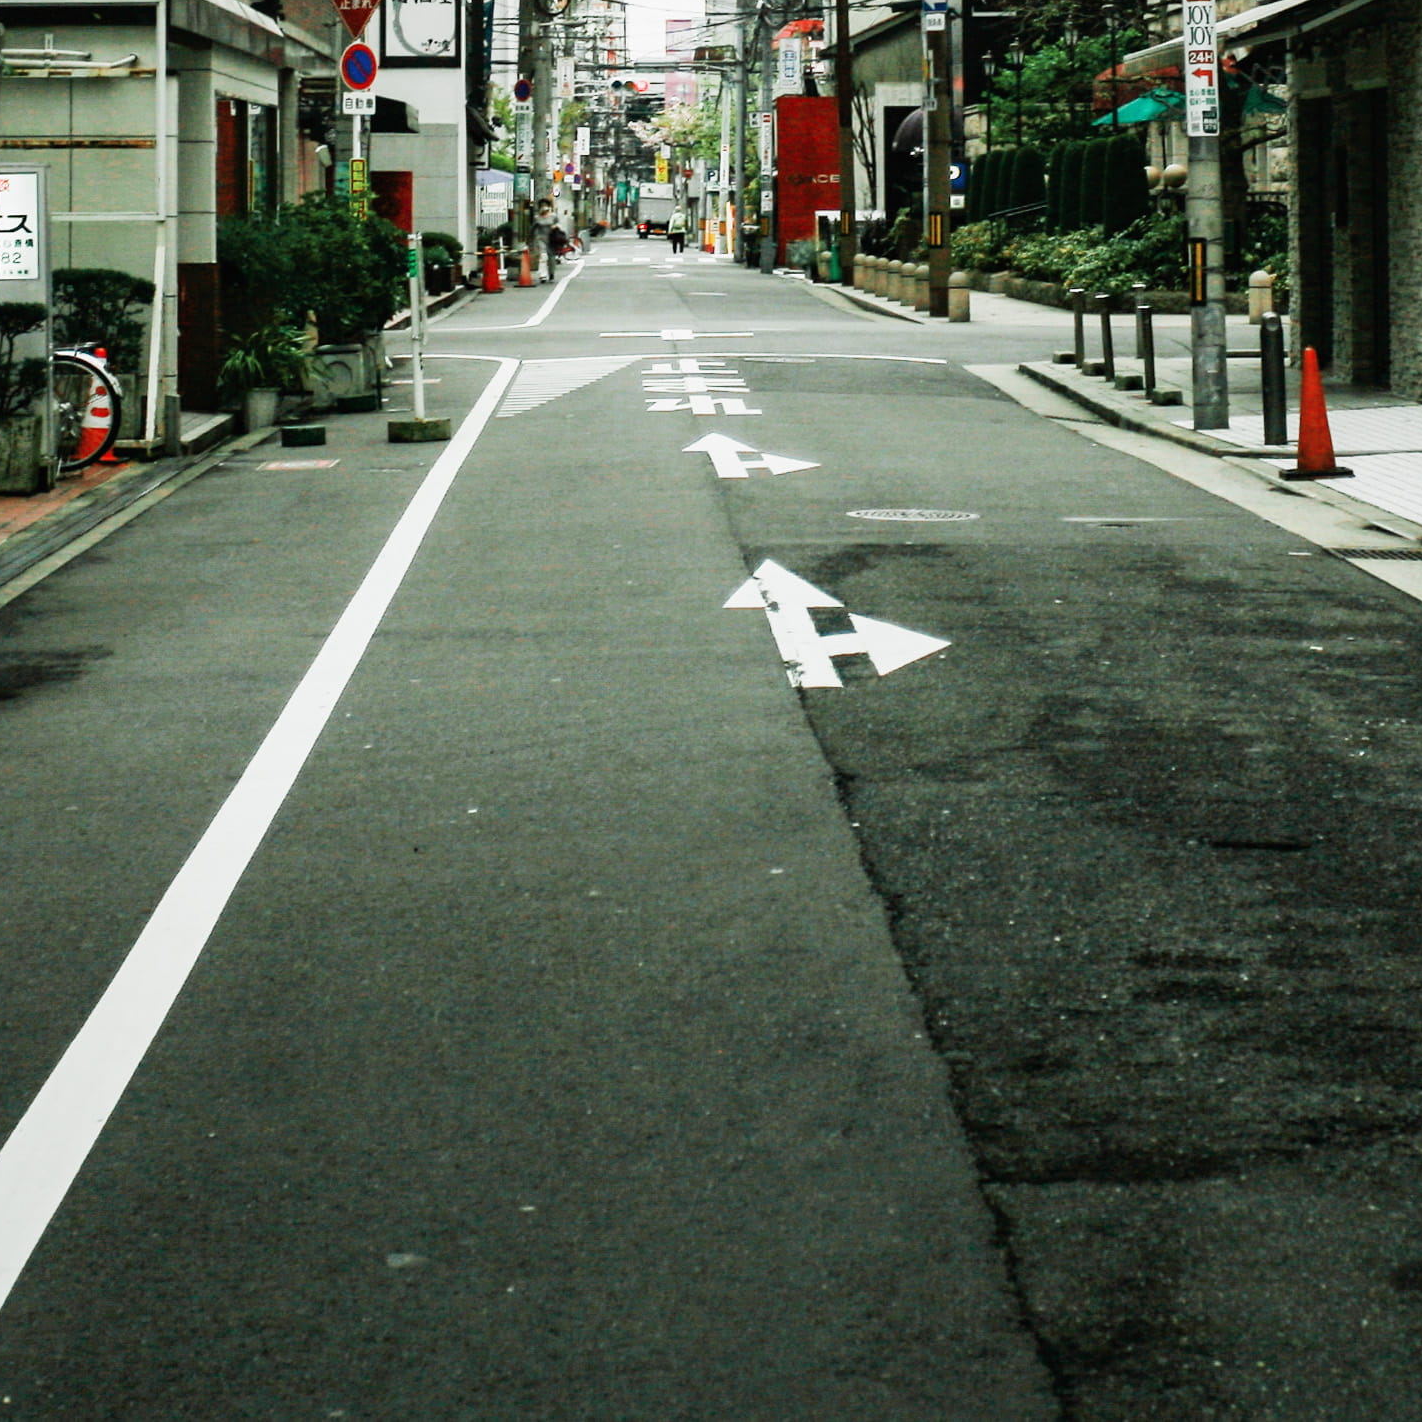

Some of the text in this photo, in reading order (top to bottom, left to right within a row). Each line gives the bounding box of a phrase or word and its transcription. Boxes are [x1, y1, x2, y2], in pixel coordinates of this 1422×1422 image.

[1186, 5, 1212, 25] JOY
[1188, 26, 1214, 46] JOY
[1188, 51, 1214, 64] 24H
[345, 97, 374, 109] 自動車
